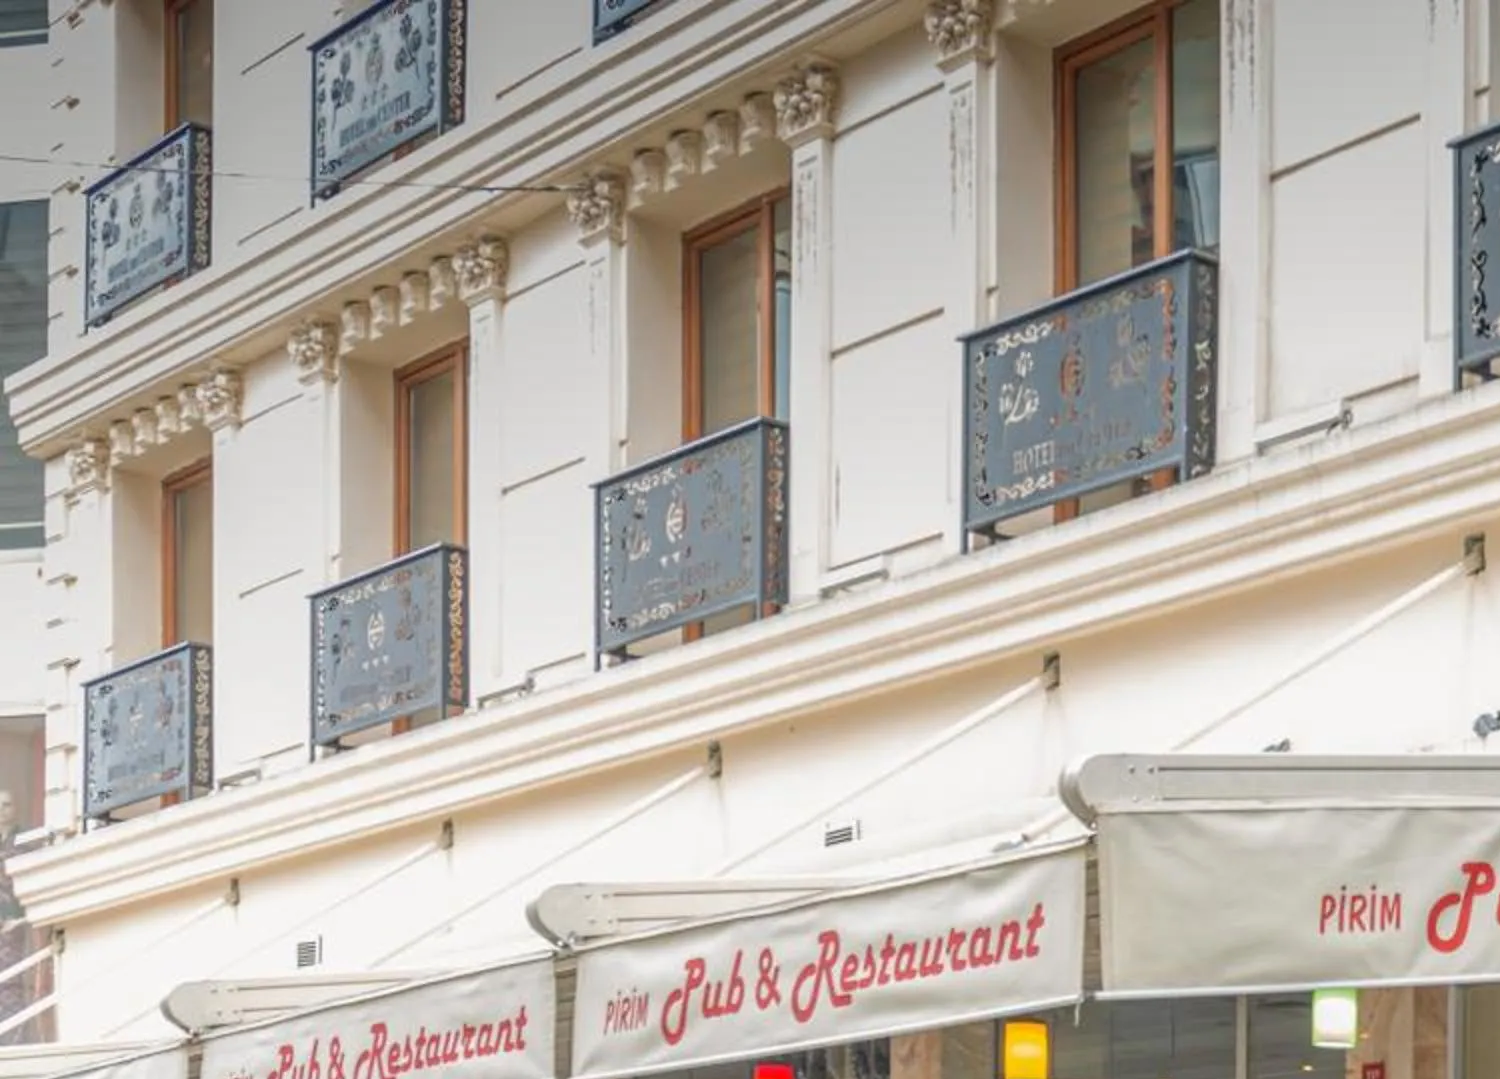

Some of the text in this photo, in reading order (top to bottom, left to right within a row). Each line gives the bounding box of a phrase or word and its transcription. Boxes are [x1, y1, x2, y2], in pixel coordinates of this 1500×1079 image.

[660, 948, 746, 1046] Pub
[754, 946, 782, 1011] &
[790, 902, 1046, 1024] Restaurant
